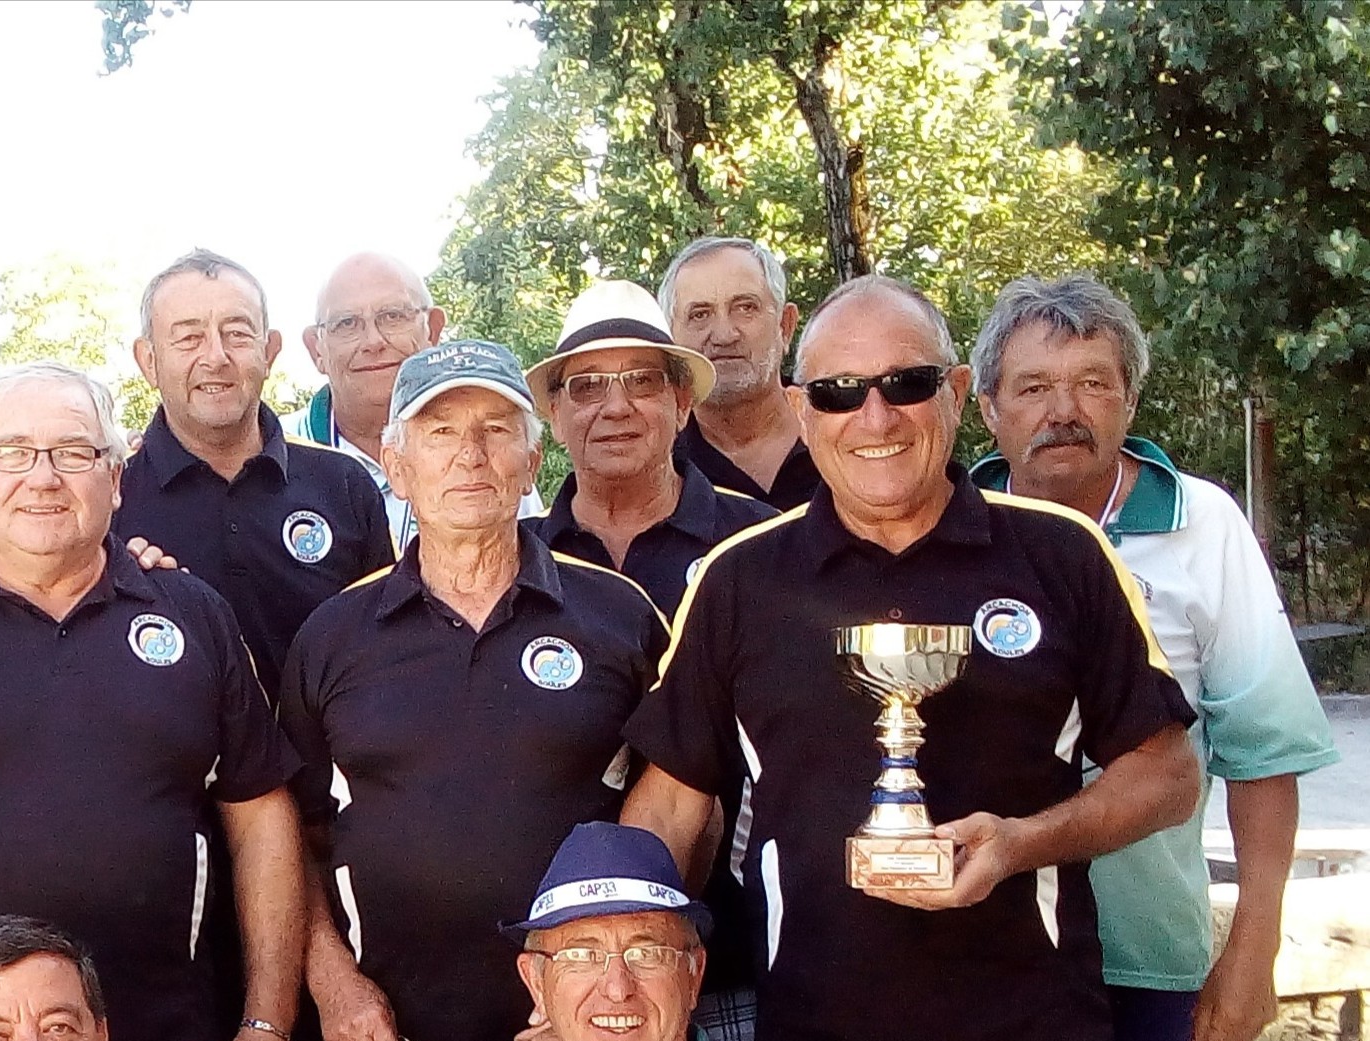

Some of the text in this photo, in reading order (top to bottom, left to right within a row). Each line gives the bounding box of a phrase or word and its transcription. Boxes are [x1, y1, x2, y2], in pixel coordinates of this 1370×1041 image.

[427, 345, 499, 365] MIAMI BEACH
[453, 356, 476, 368] FL
[980, 600, 1031, 615] ARCACHON
[530, 638, 574, 654] ARCACHON
[579, 881, 617, 898] CAP33
